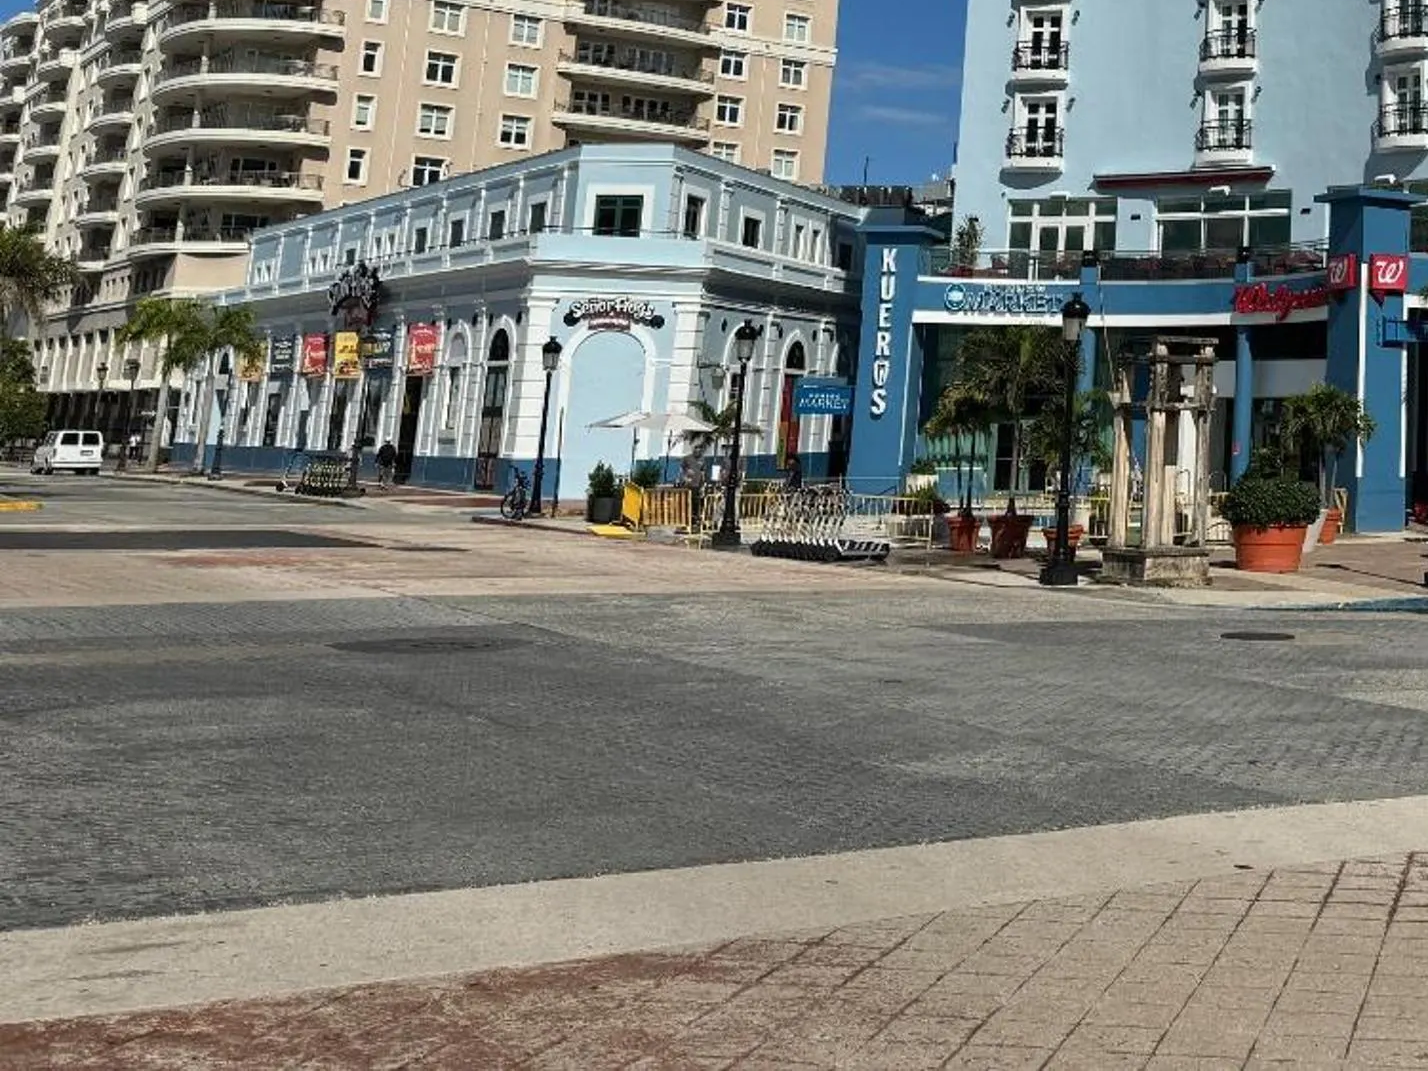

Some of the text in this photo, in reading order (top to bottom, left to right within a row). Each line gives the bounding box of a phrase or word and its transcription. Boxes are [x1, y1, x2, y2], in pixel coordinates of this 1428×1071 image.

[1376, 261, 1403, 283] W
[571, 297, 614, 318] Señor
[799, 398, 849, 409] MARKET
